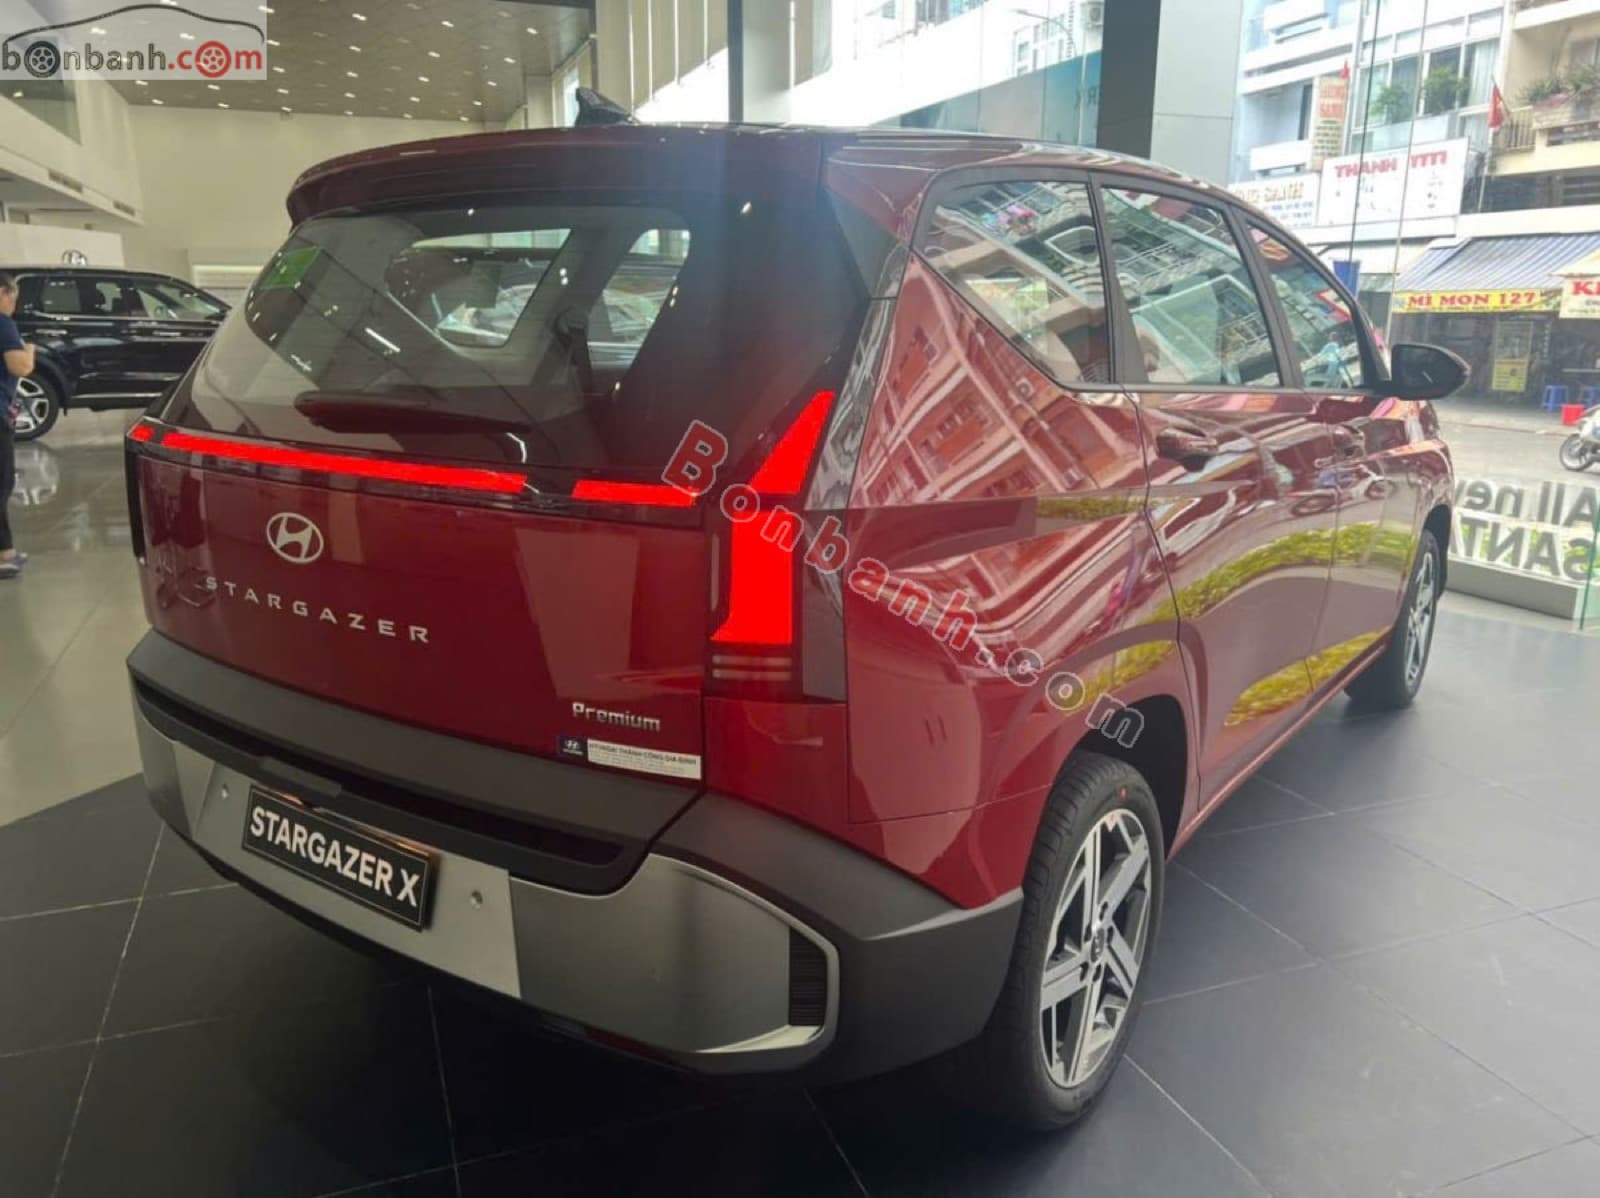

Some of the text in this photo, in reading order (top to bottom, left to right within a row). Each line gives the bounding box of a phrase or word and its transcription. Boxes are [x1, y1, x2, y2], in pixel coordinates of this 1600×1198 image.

[1499, 292, 1536, 305] 127
[205, 576, 430, 644] STARGAZER
[572, 701, 661, 732] Premium
[250, 806, 421, 908] STARGAZER X
